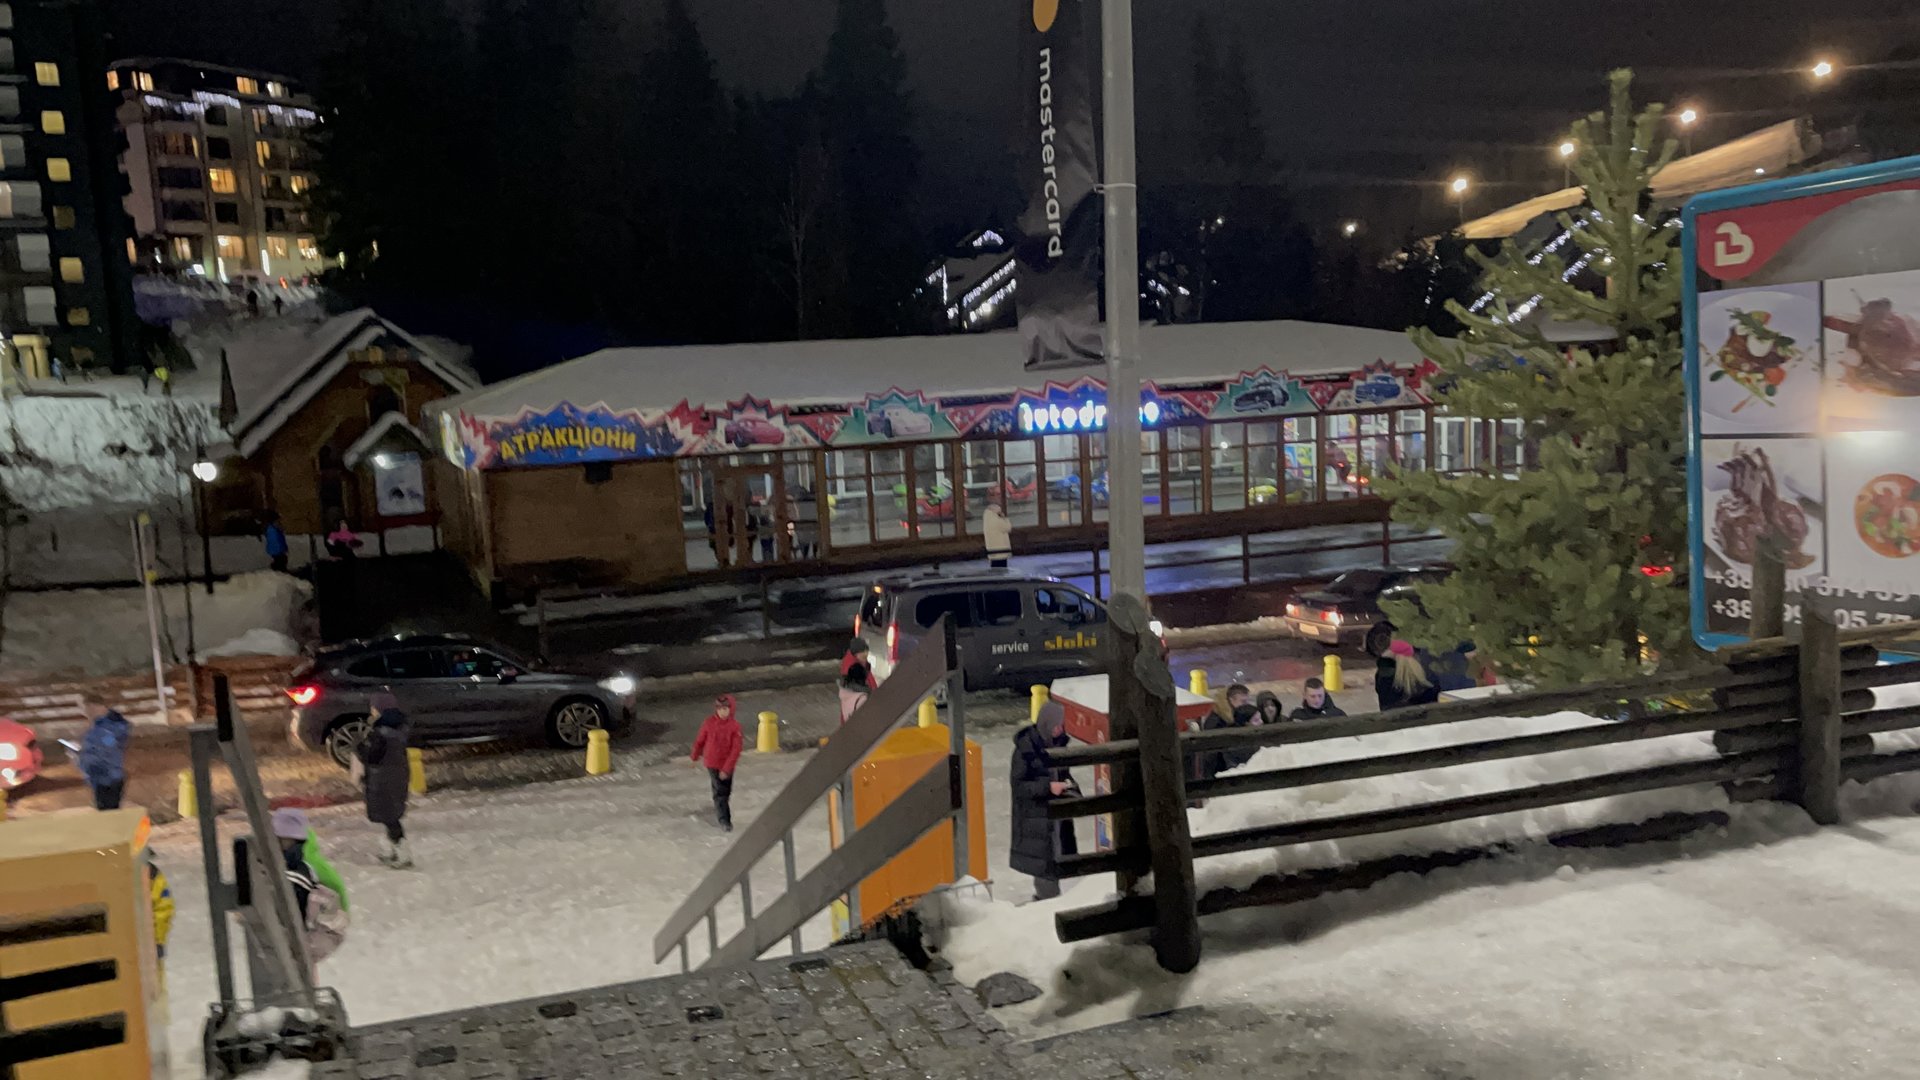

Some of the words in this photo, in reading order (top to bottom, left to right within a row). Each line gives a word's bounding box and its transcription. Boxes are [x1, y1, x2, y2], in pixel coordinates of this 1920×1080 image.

[1040, 48, 1063, 258] mastercard
[501, 426, 637, 461] АТРАКЦІОНИ
[991, 641, 1029, 655] service
